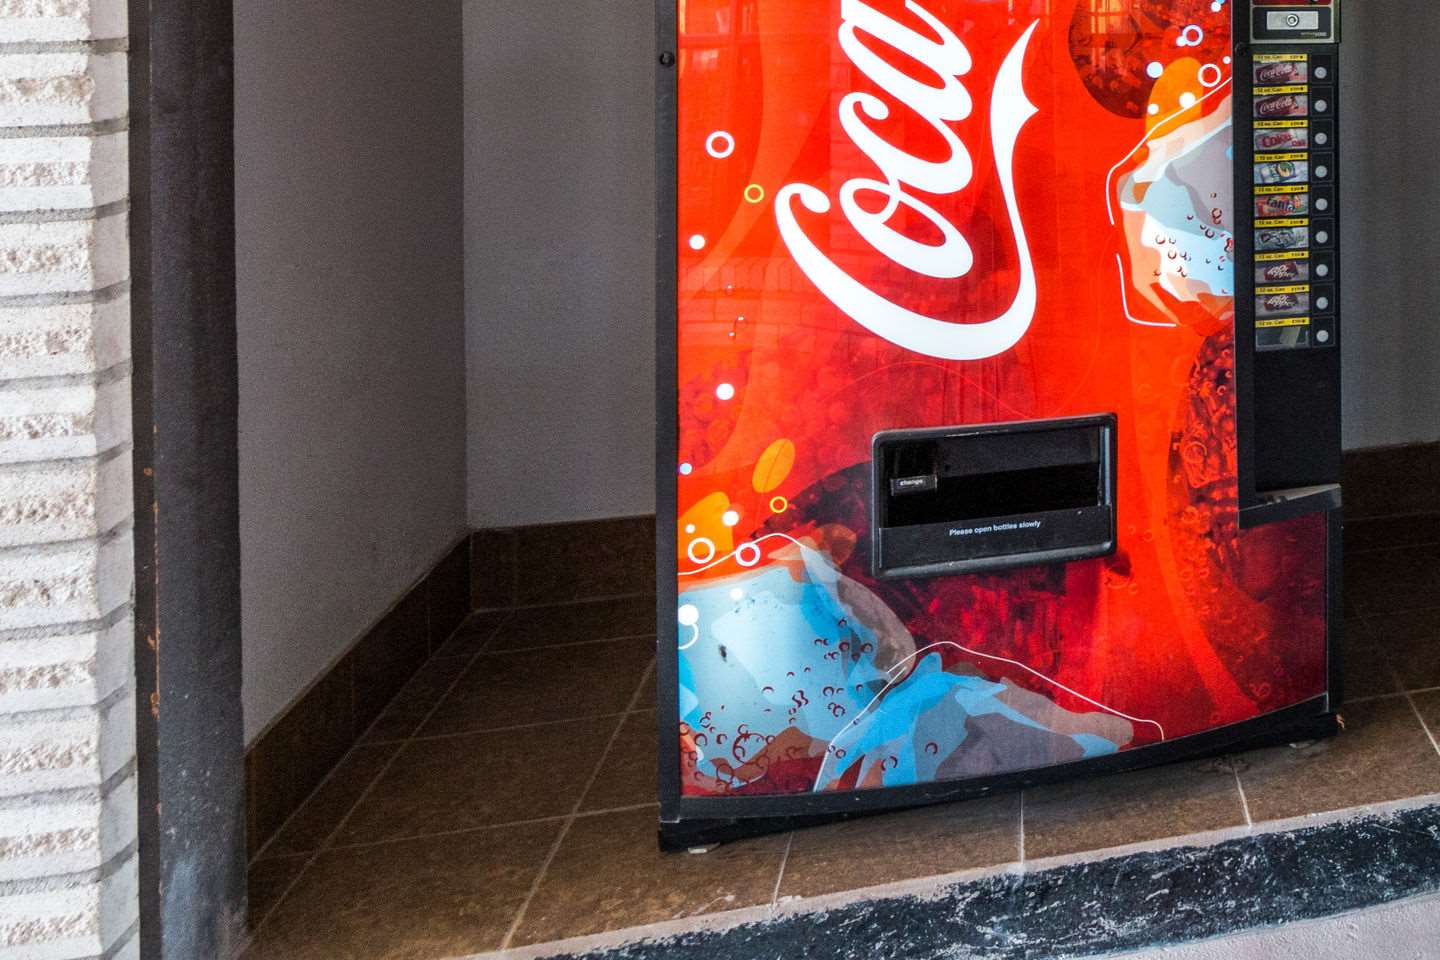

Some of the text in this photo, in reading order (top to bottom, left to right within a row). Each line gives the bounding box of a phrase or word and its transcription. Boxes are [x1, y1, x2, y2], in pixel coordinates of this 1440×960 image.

[900, 479, 923, 488] change
[949, 520, 1041, 536] Please open bottles slowly
